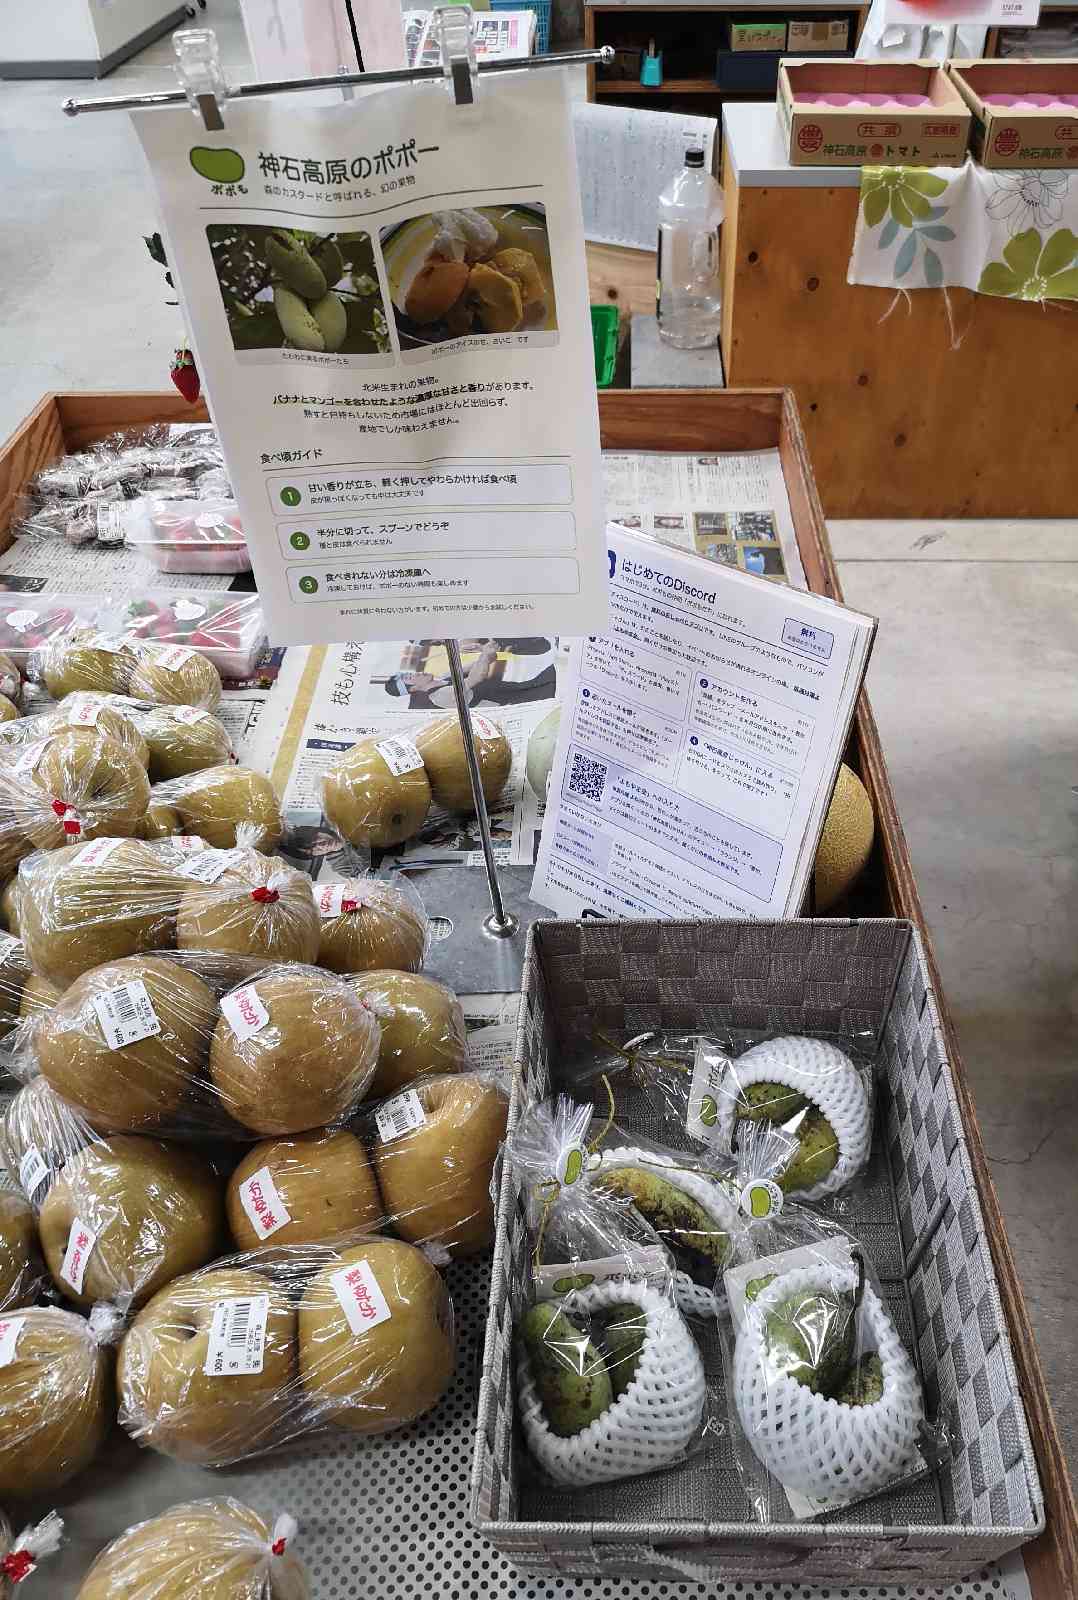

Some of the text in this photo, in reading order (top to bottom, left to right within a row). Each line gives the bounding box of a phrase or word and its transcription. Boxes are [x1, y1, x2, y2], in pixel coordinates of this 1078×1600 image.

[258, 139, 440, 185] 神石高原のポポー
[260, 448, 323, 465] 食べ頃ガイド
[621, 558, 717, 605] はじめてのDiscord
